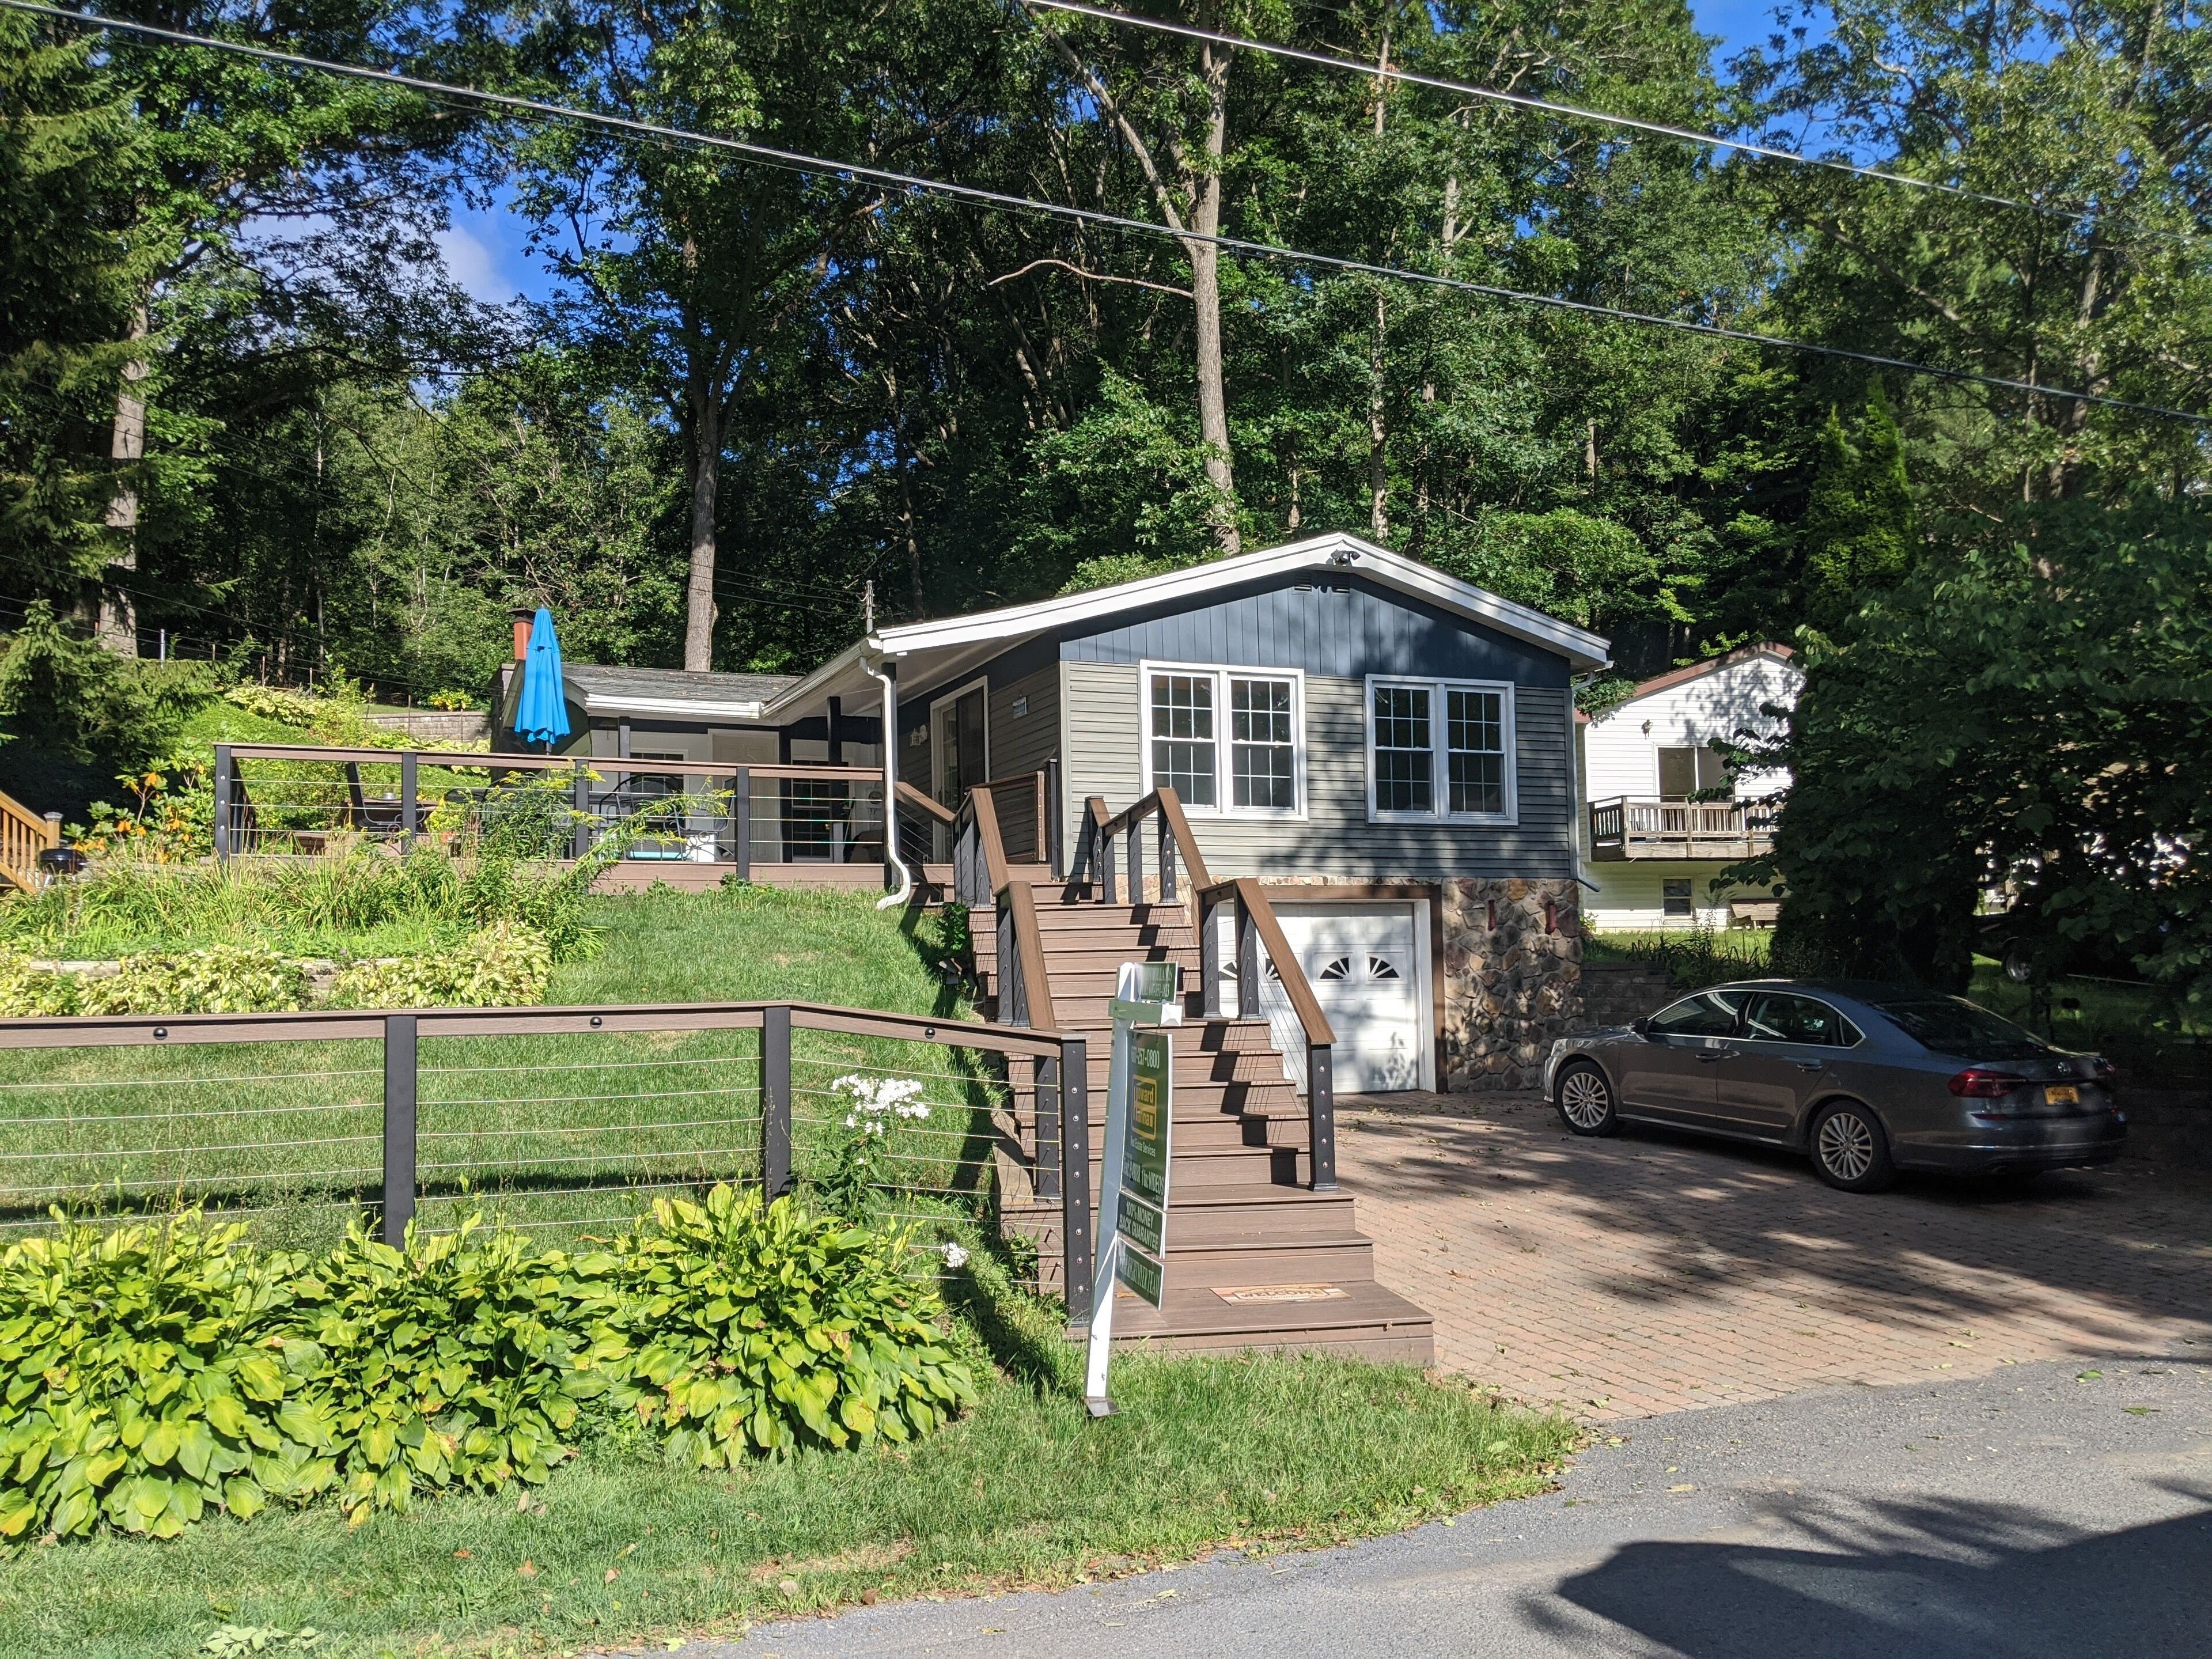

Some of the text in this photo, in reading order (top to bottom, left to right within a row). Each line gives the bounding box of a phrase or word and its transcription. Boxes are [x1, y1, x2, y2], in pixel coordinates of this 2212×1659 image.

[1133, 1086, 1154, 1104] Howard
[1143, 1141, 1156, 1157] Services
[1149, 1171, 1164, 1195] VIDEOS
[1126, 1201, 1154, 1229] 100% MONEY
[1119, 1214, 1159, 1251] BACK GUARANTEE
